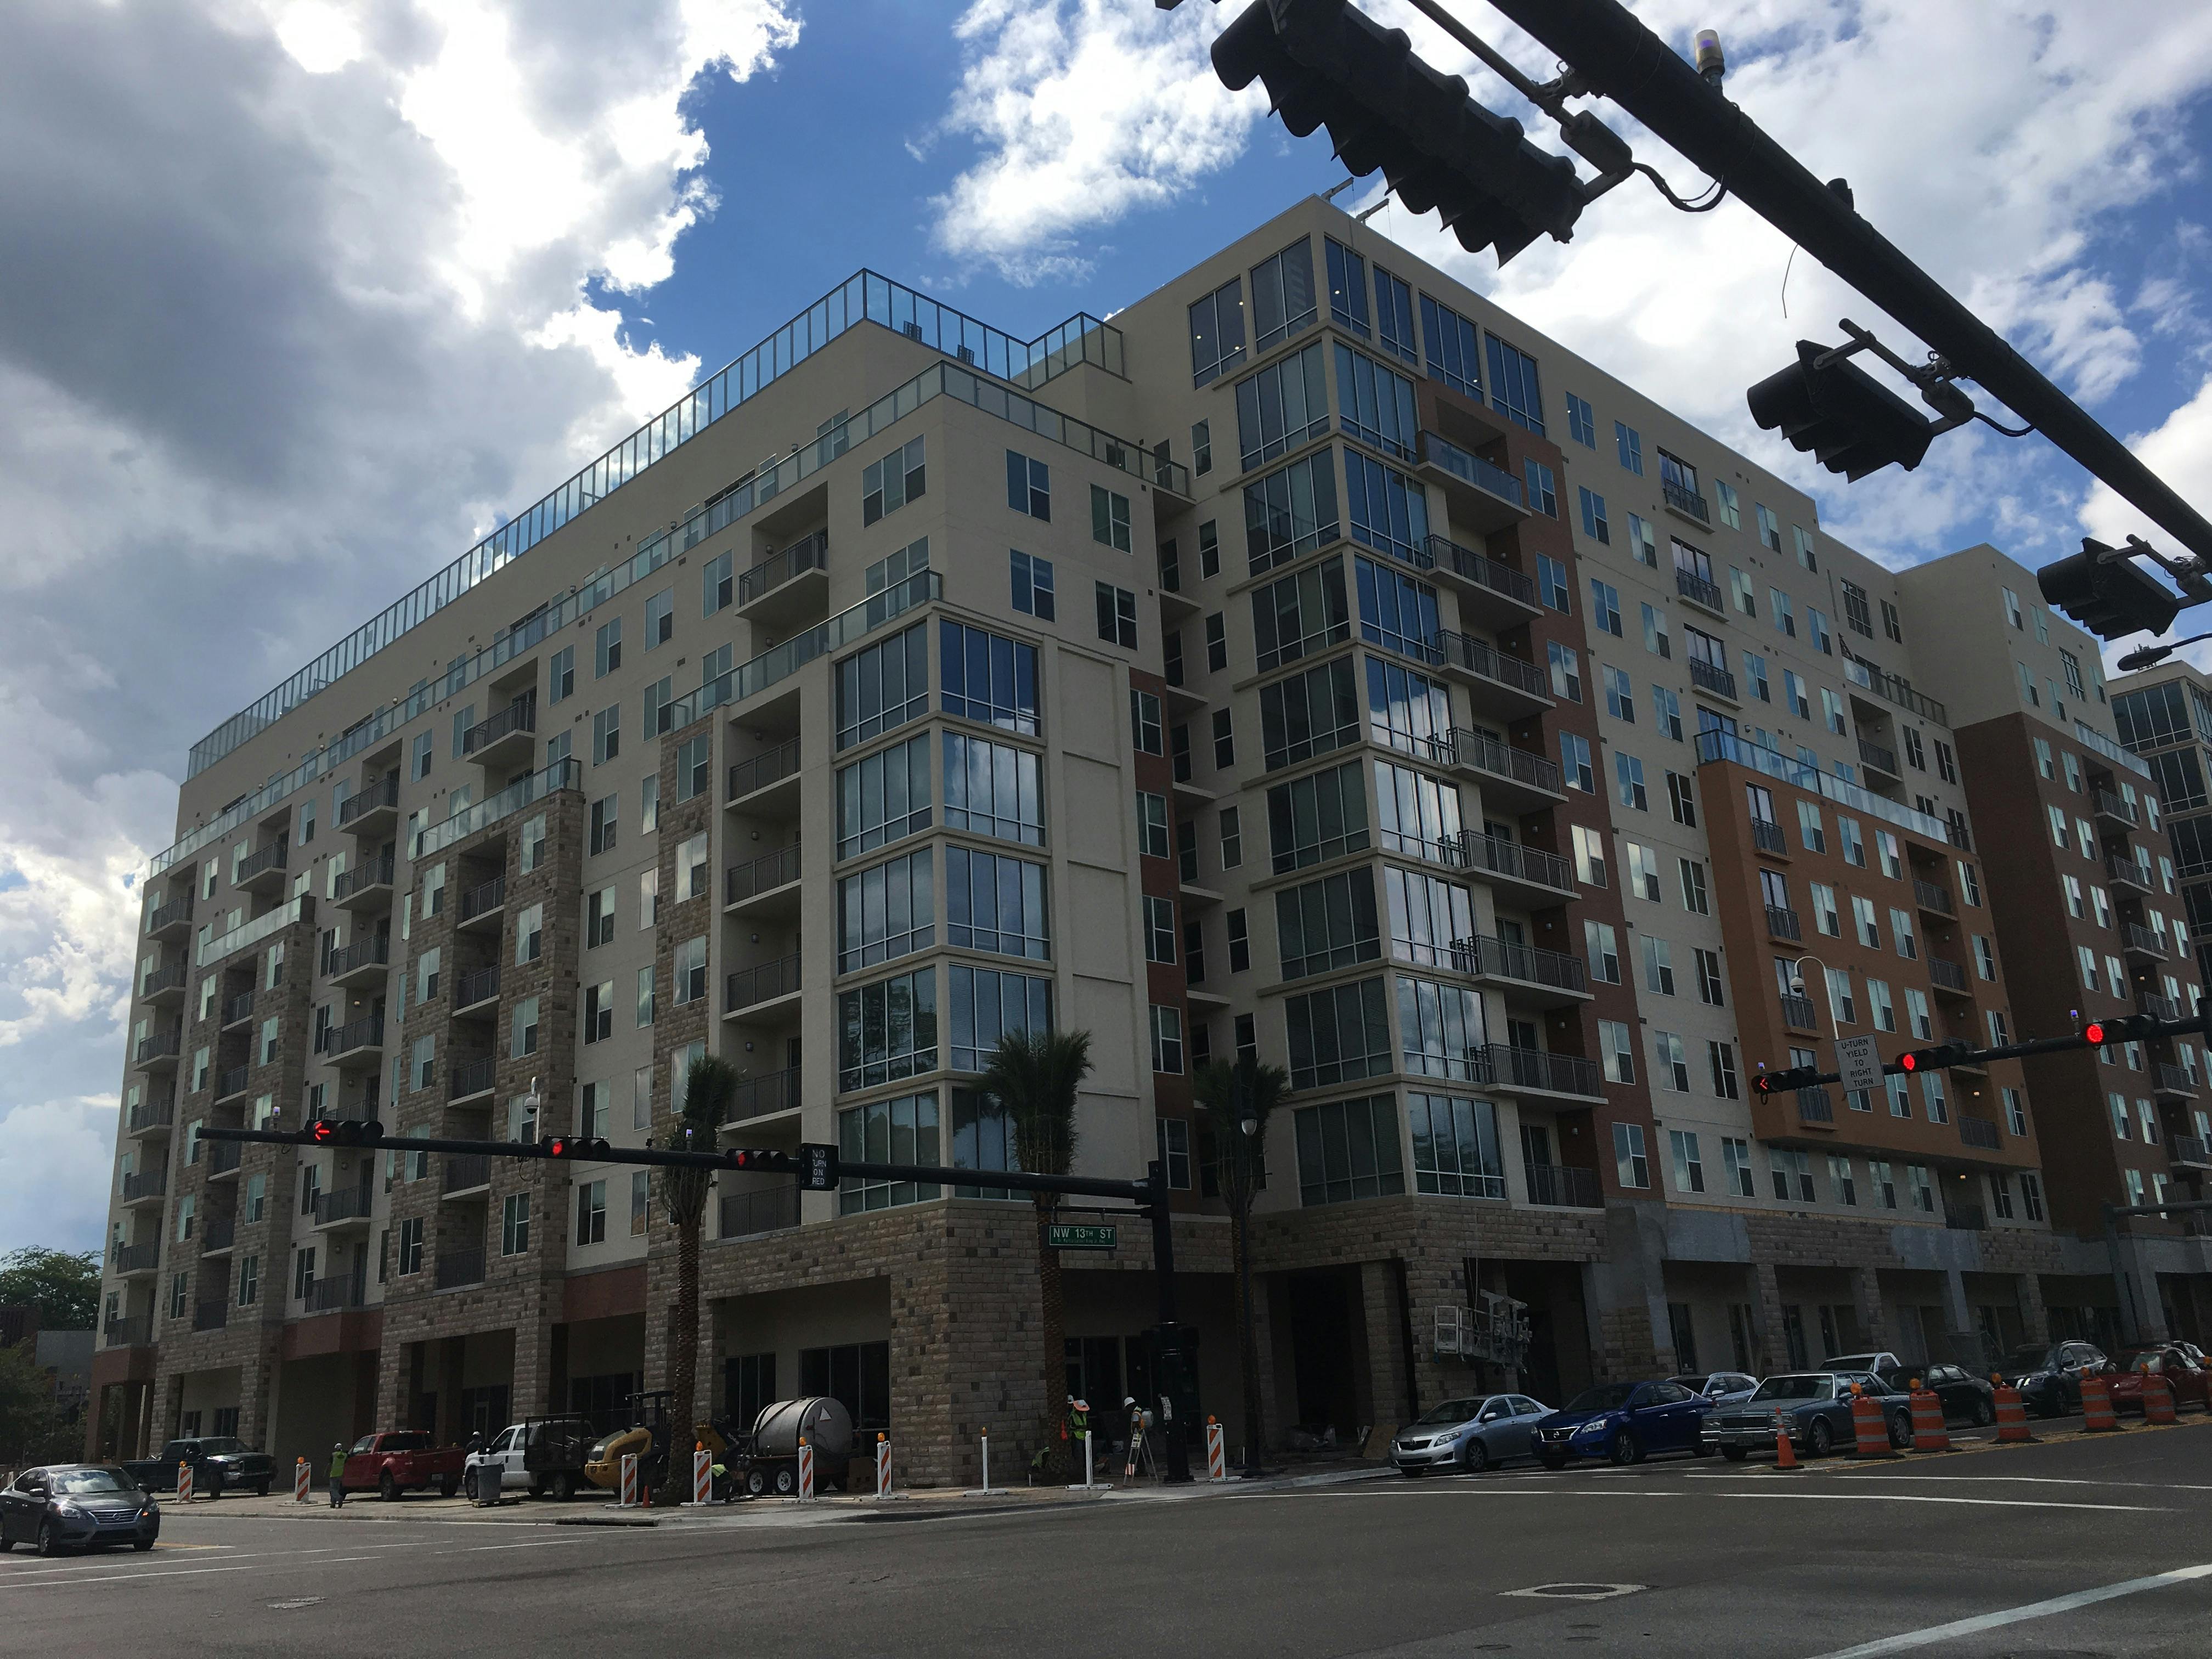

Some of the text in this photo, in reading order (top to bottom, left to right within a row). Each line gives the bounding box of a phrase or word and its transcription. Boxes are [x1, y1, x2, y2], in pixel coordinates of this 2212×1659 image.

[1841, 1038, 1869, 1049] U-TURN
[1846, 1048, 1868, 1058] YIELD
[1850, 1068, 1872, 1077] RIGHT
[1853, 1077, 1874, 1087] TURN
[812, 1149, 825, 1158] NO
[1053, 1228, 1112, 1239] NW 13TH ST
